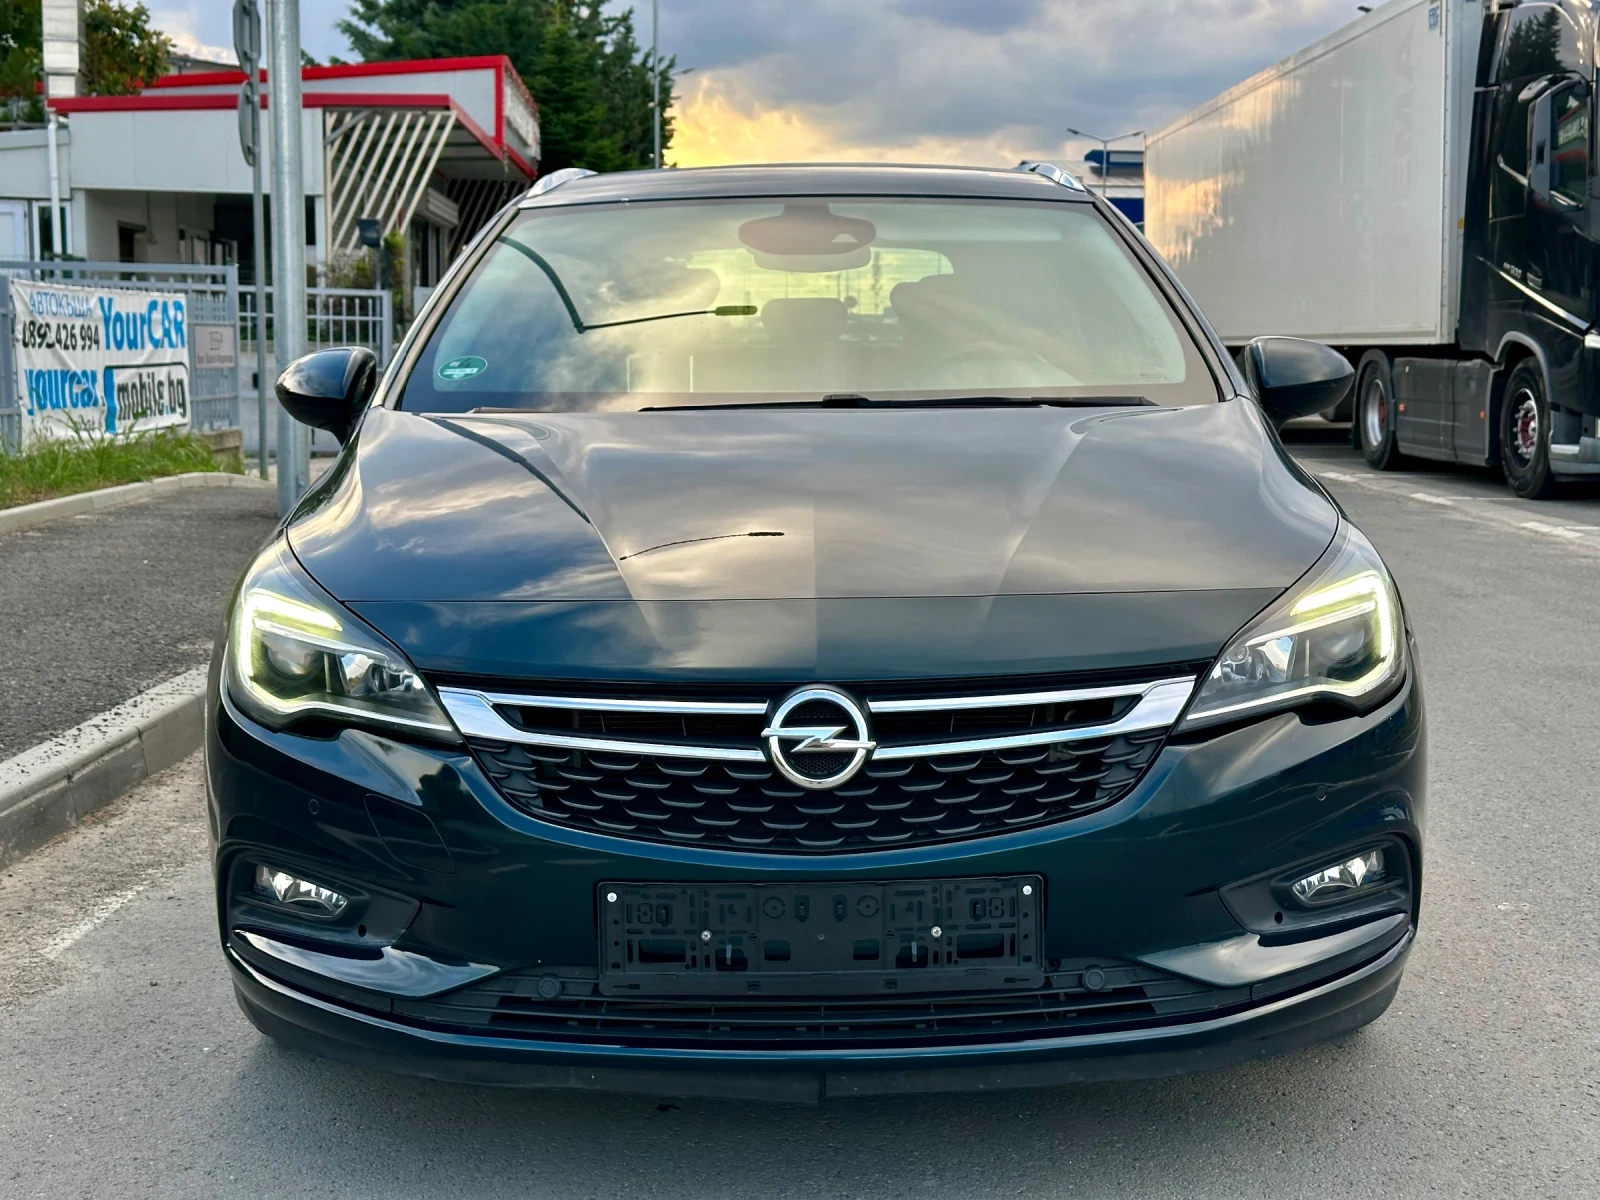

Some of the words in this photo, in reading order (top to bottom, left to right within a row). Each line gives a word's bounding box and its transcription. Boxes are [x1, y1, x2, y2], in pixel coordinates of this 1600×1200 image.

[55, 322, 78, 351] 426
[79, 323, 101, 351] 994
[98, 295, 186, 351] YourCAR
[117, 370, 187, 421] mobile.bg
